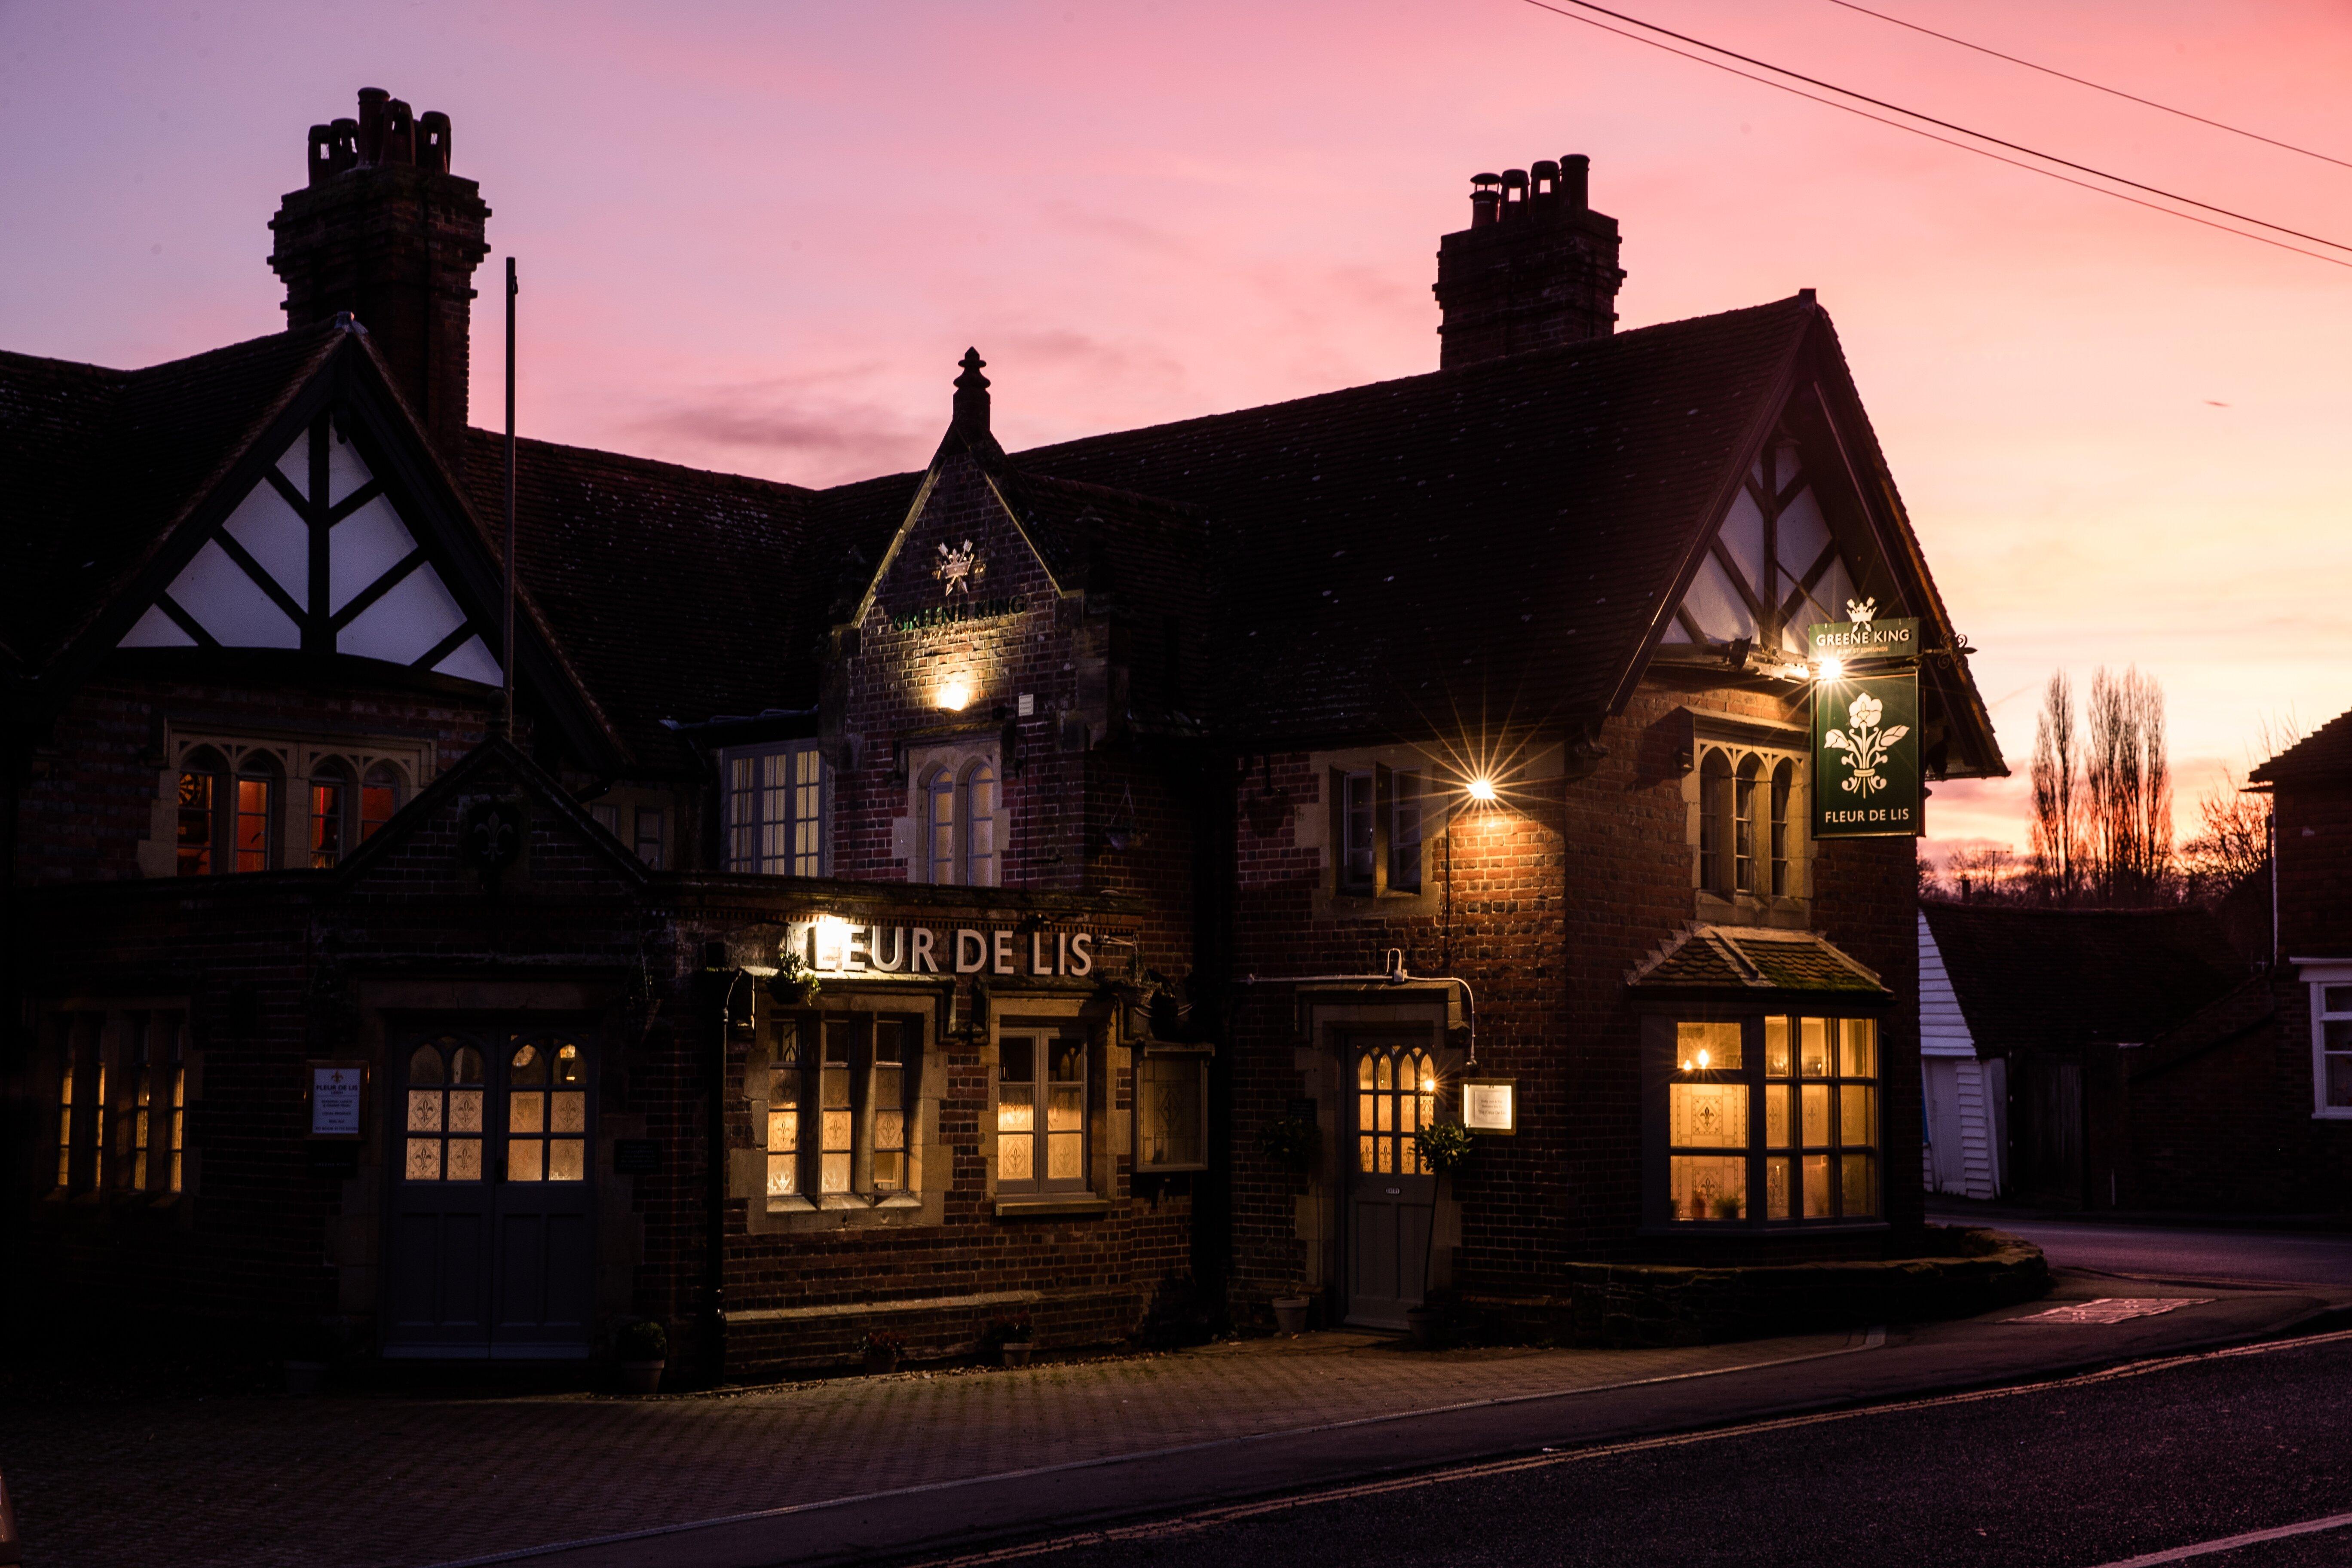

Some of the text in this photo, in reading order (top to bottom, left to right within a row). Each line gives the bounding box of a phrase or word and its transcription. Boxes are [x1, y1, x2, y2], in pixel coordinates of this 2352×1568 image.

[894, 596, 1026, 631] GREENE KING
[1816, 629, 1910, 646] GREENE KING
[1825, 808, 1909, 823] FLEUR DE LIS
[956, 928, 1014, 974] DE
[1033, 932, 1092, 977] LIS
